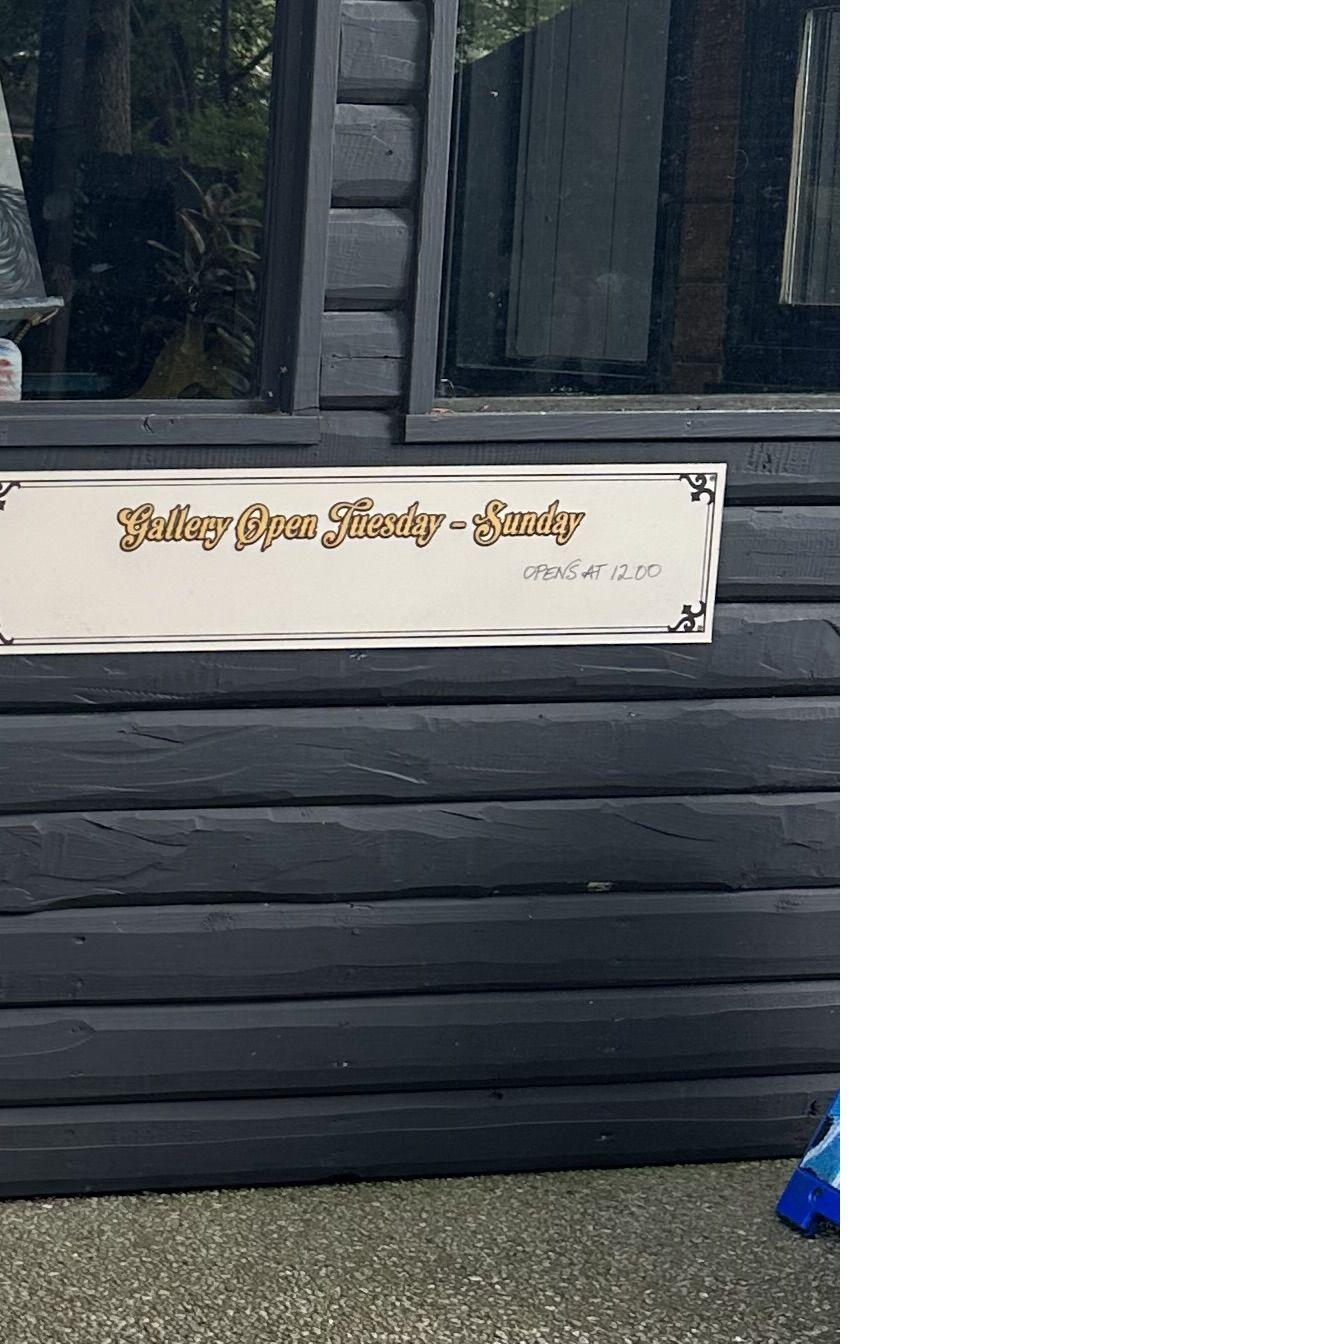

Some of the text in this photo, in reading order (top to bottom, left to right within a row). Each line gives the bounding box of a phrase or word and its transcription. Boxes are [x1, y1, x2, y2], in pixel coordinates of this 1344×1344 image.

[116, 503, 234, 552] Gallery
[234, 503, 318, 552] Open
[321, 497, 447, 548] Tuesday
[473, 499, 586, 547] Sunday
[523, 558, 582, 581] OPENS
[581, 563, 608, 581] AT
